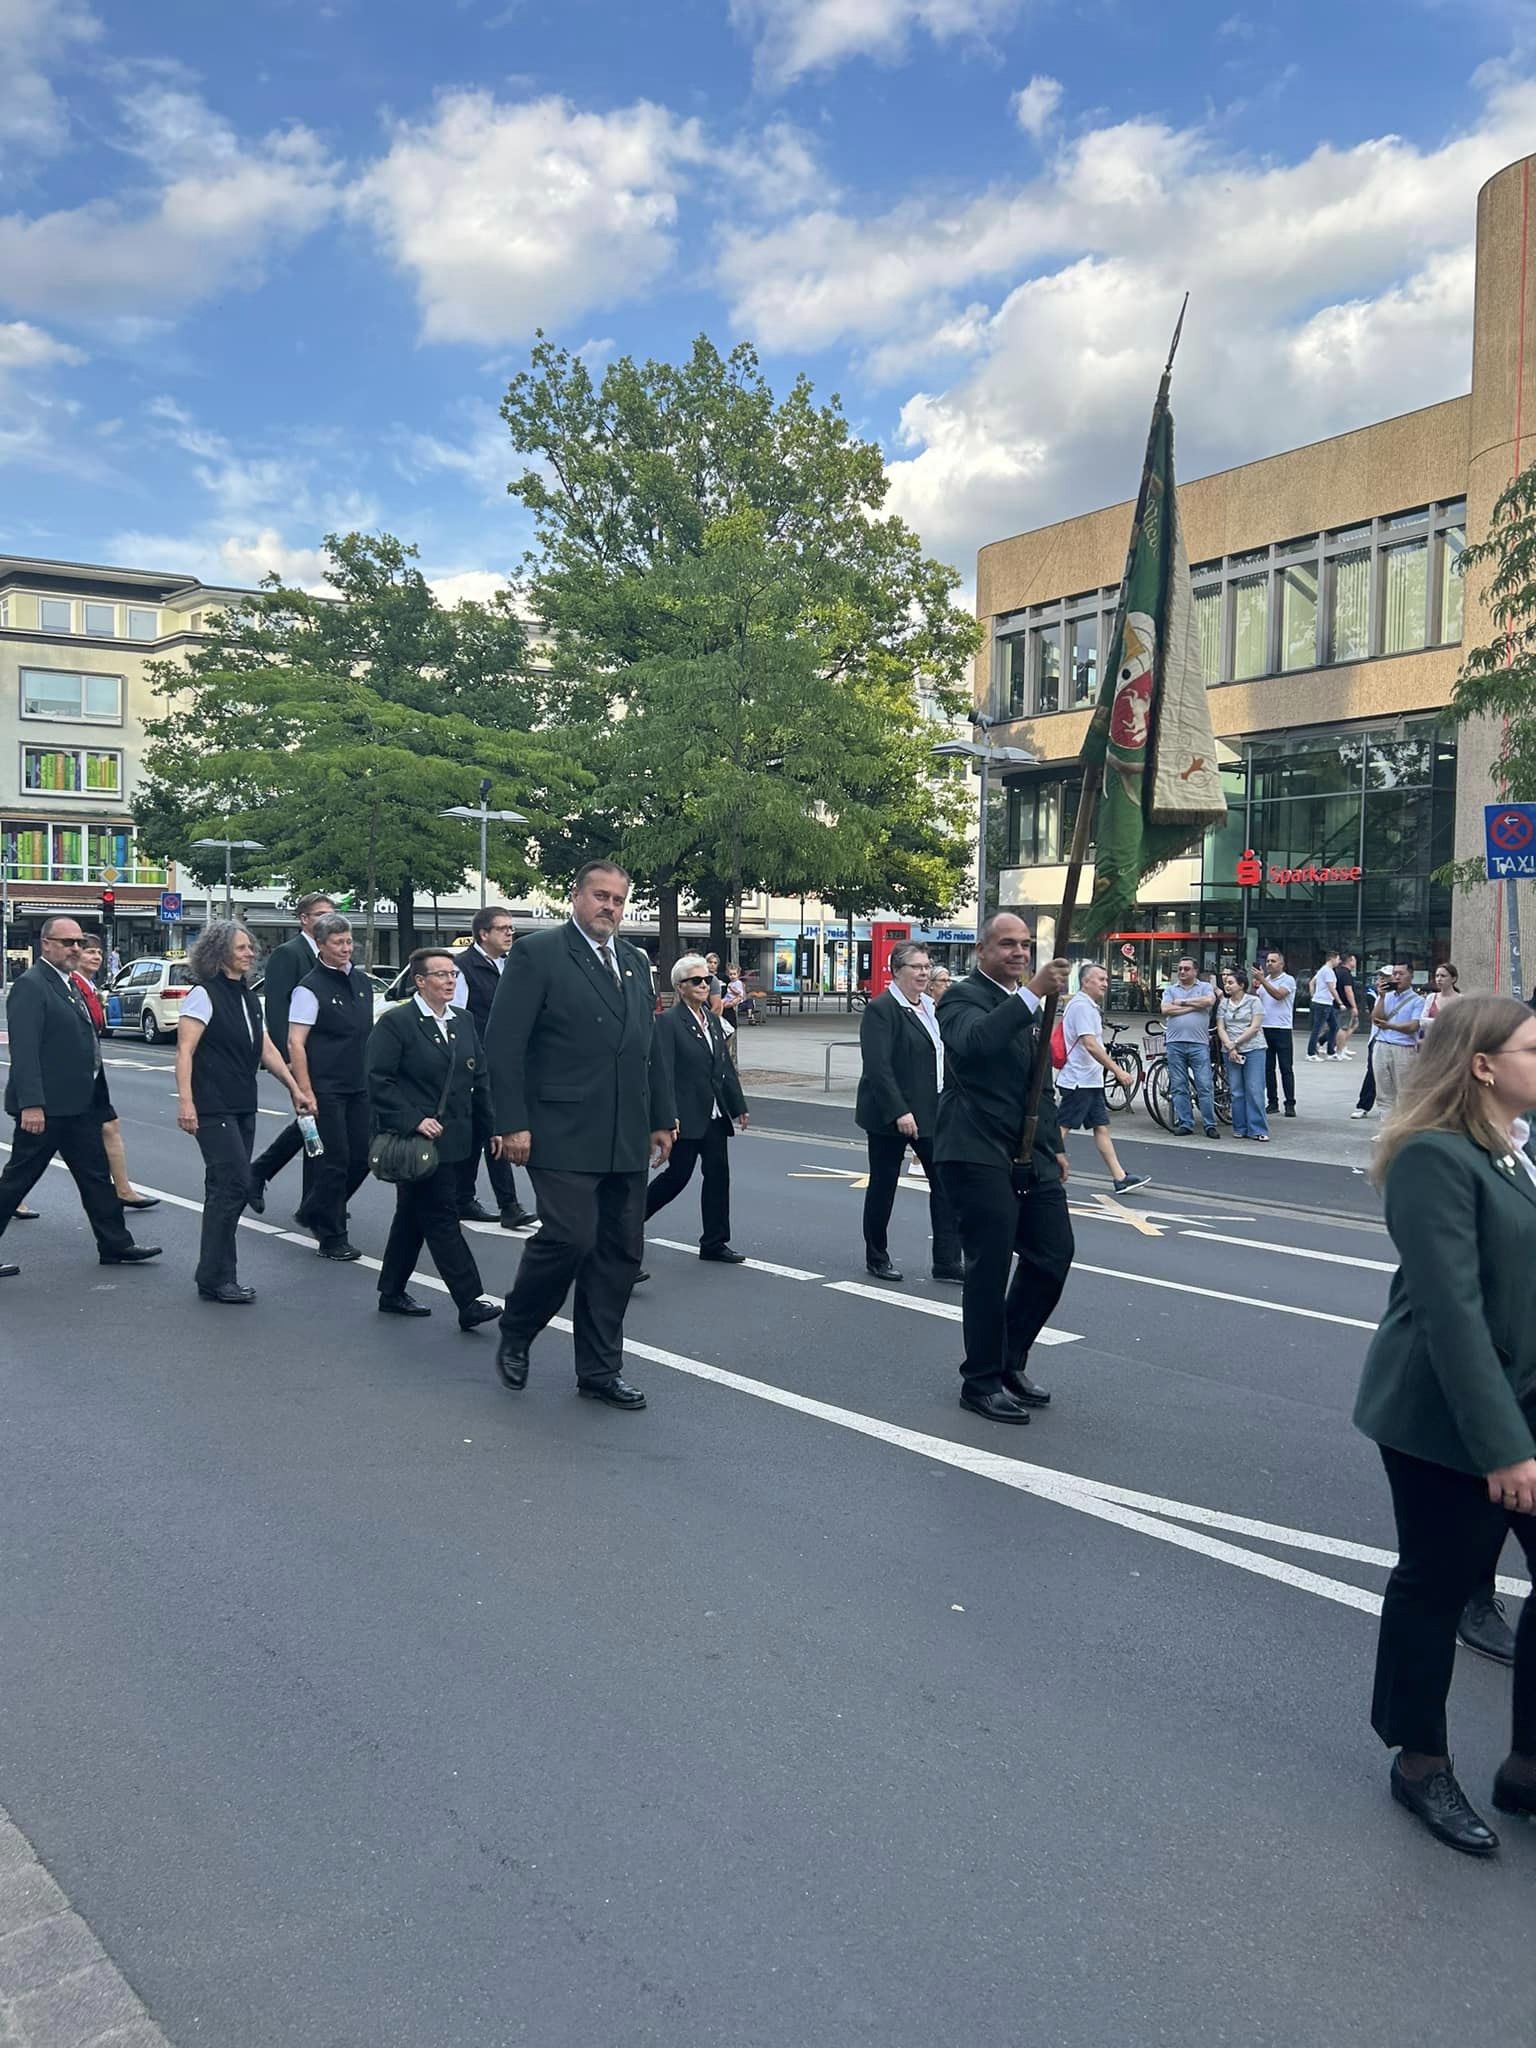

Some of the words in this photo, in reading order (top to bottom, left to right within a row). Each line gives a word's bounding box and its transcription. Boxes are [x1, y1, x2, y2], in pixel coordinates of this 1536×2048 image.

[1491, 856, 1534, 873] TAXI
[1269, 864, 1361, 888] Sparkasse
[936, 930, 952, 940] JHS
[953, 931, 975, 941] reisen
